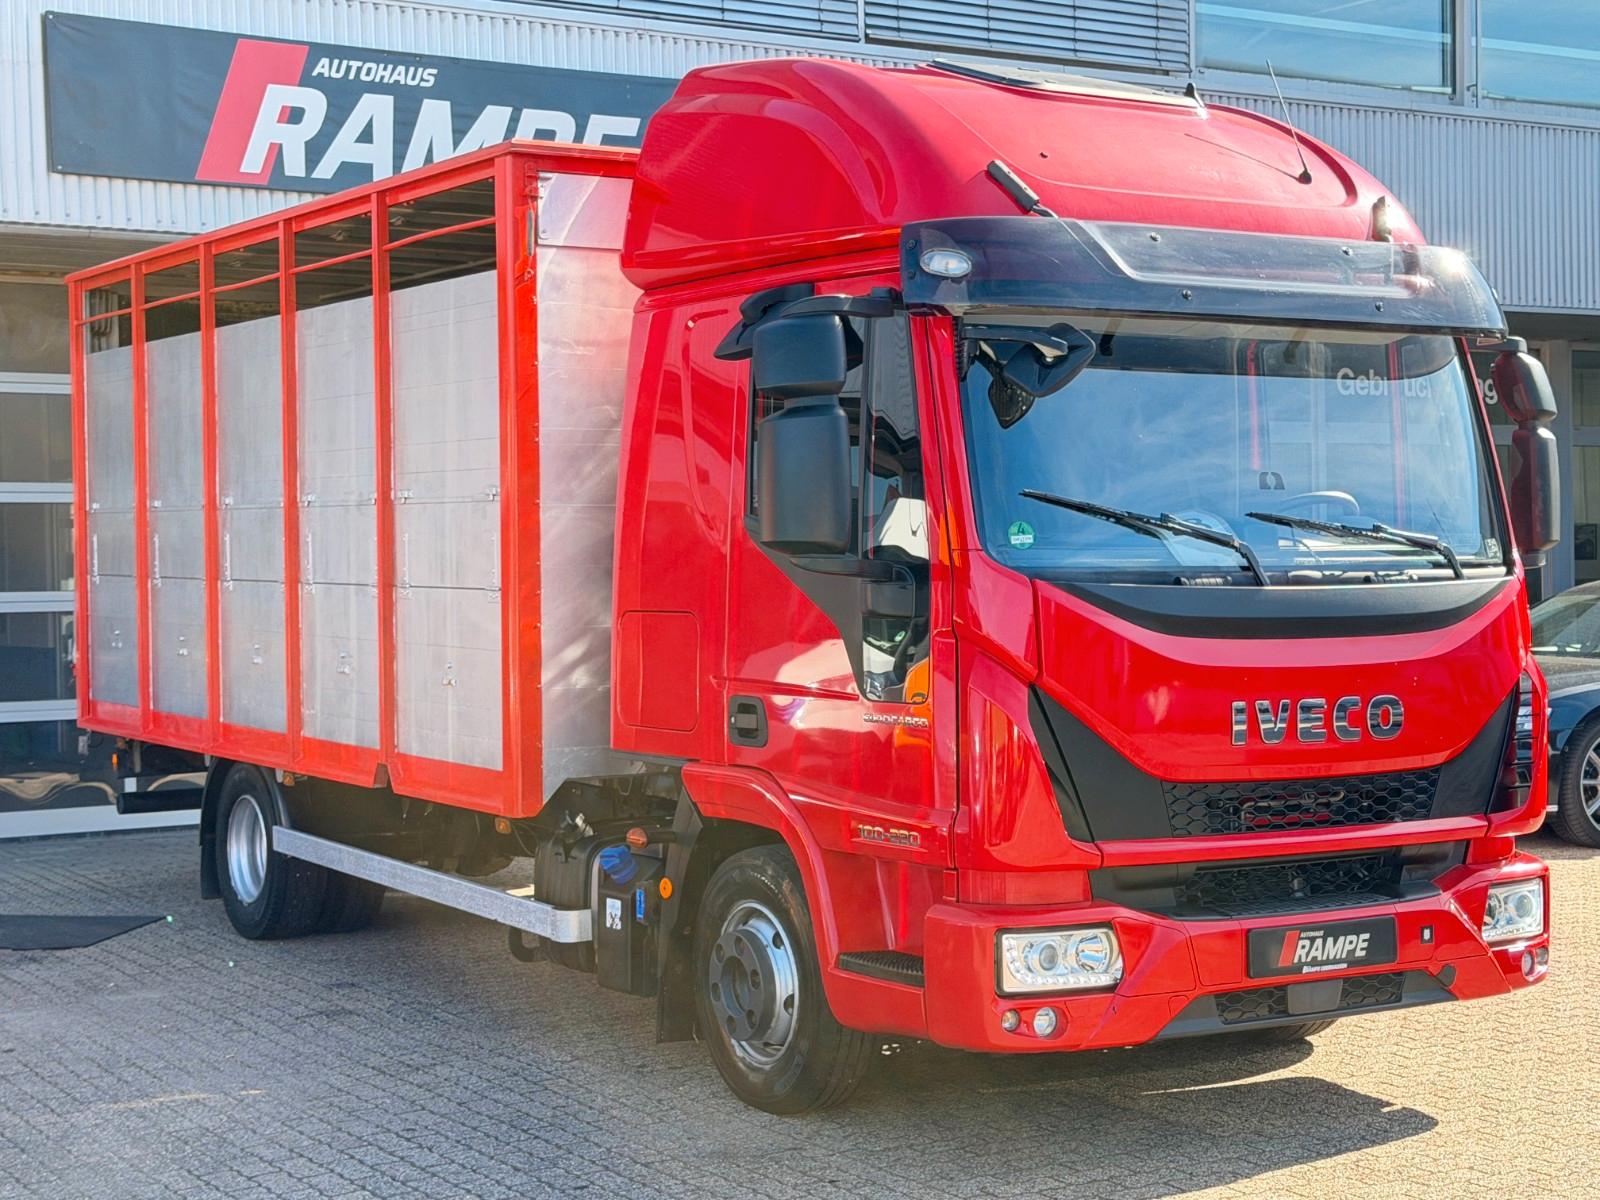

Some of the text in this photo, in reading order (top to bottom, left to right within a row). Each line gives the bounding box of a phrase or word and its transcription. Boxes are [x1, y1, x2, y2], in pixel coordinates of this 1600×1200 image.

[312, 57, 438, 88] AUTOHAUS
[1231, 694, 1404, 746] IVECO
[1293, 932, 1370, 964] RAMPE
